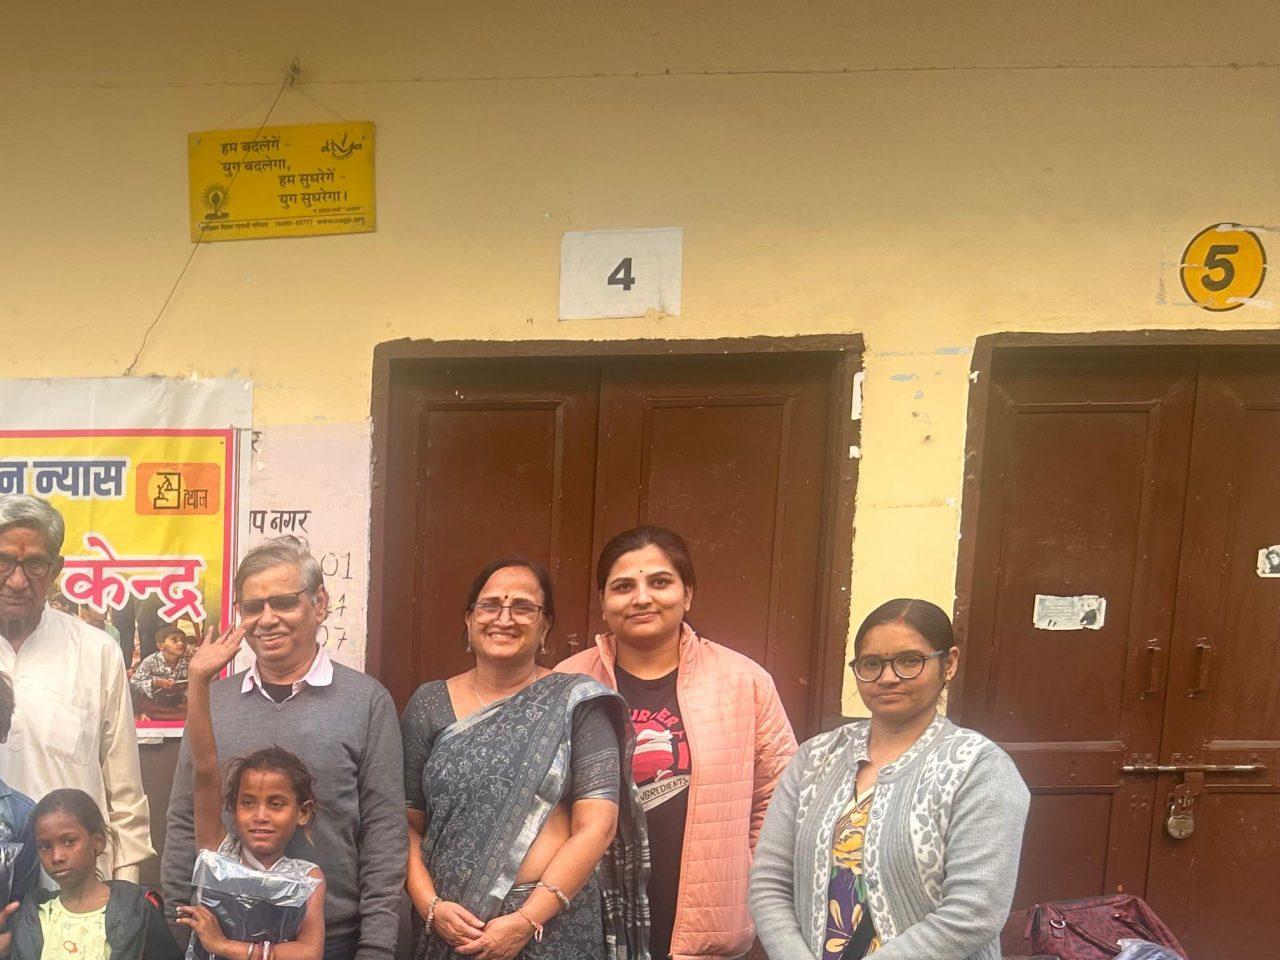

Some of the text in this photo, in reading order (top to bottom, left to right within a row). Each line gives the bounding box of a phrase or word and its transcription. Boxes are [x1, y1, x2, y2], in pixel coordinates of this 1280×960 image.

[220, 142, 238, 156] हम
[221, 162, 240, 177] युग
[278, 174, 295, 187] हम
[278, 193, 297, 209] युग
[607, 257, 636, 291] 4
[1200, 244, 1239, 292] 5
[33, 460, 127, 496] न्यास
[270, 510, 311, 534] नगर
[64, 536, 202, 618] केन्द्र
